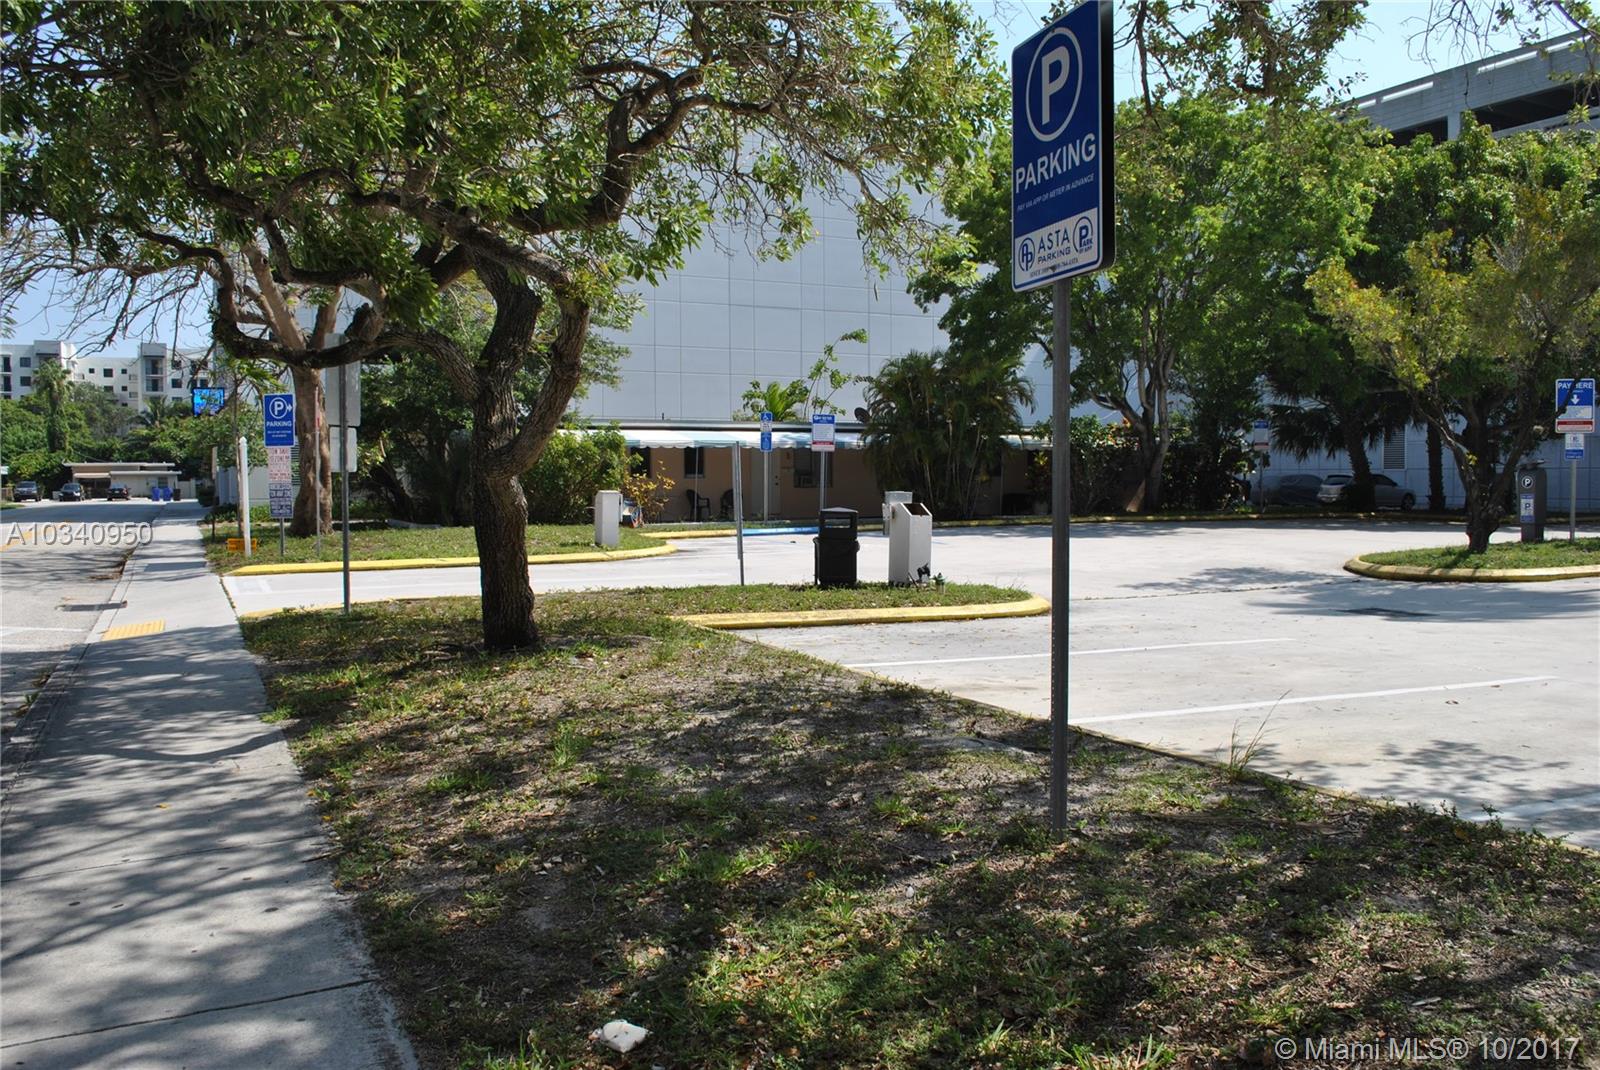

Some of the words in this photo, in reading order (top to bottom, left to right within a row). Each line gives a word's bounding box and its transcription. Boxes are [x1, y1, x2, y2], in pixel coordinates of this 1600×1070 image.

[1042, 45, 1070, 125] P
[1015, 132, 1096, 194] PARKING
[1037, 227, 1070, 254] ASTA
[1037, 246, 1071, 264] PARKING
[1557, 381, 1572, 389] PAY
[274, 400, 284, 415] P
[1524, 478, 1531, 486] P
